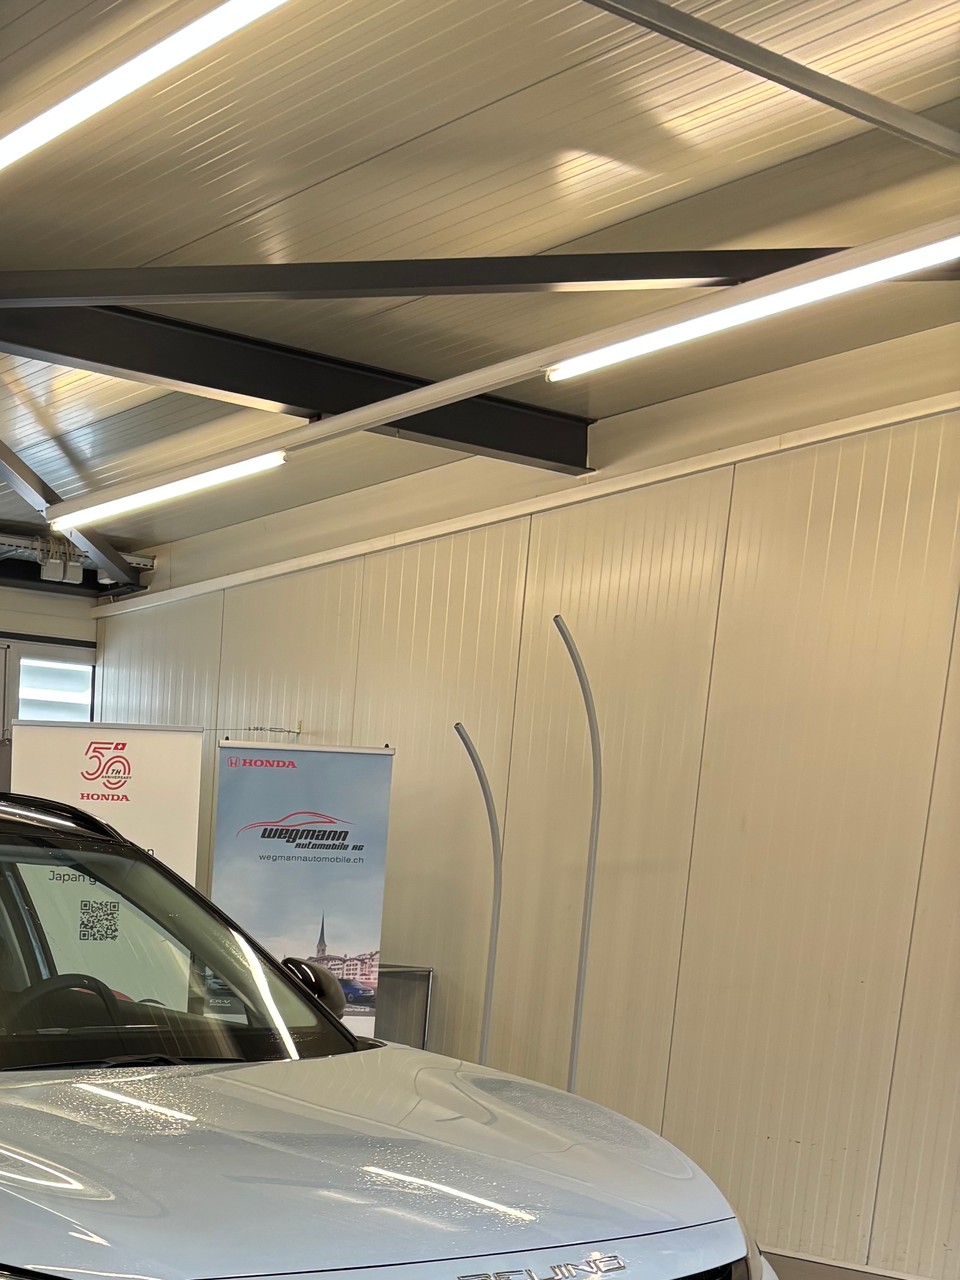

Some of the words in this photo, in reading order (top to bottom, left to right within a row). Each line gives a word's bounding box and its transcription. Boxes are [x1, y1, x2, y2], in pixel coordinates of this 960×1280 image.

[242, 758, 297, 768] HONDA
[80, 793, 130, 801] HONDA
[260, 827, 349, 843] wegmann
[258, 854, 364, 864] wegmannautomobile.ch
[48, 870, 85, 883] Japan
